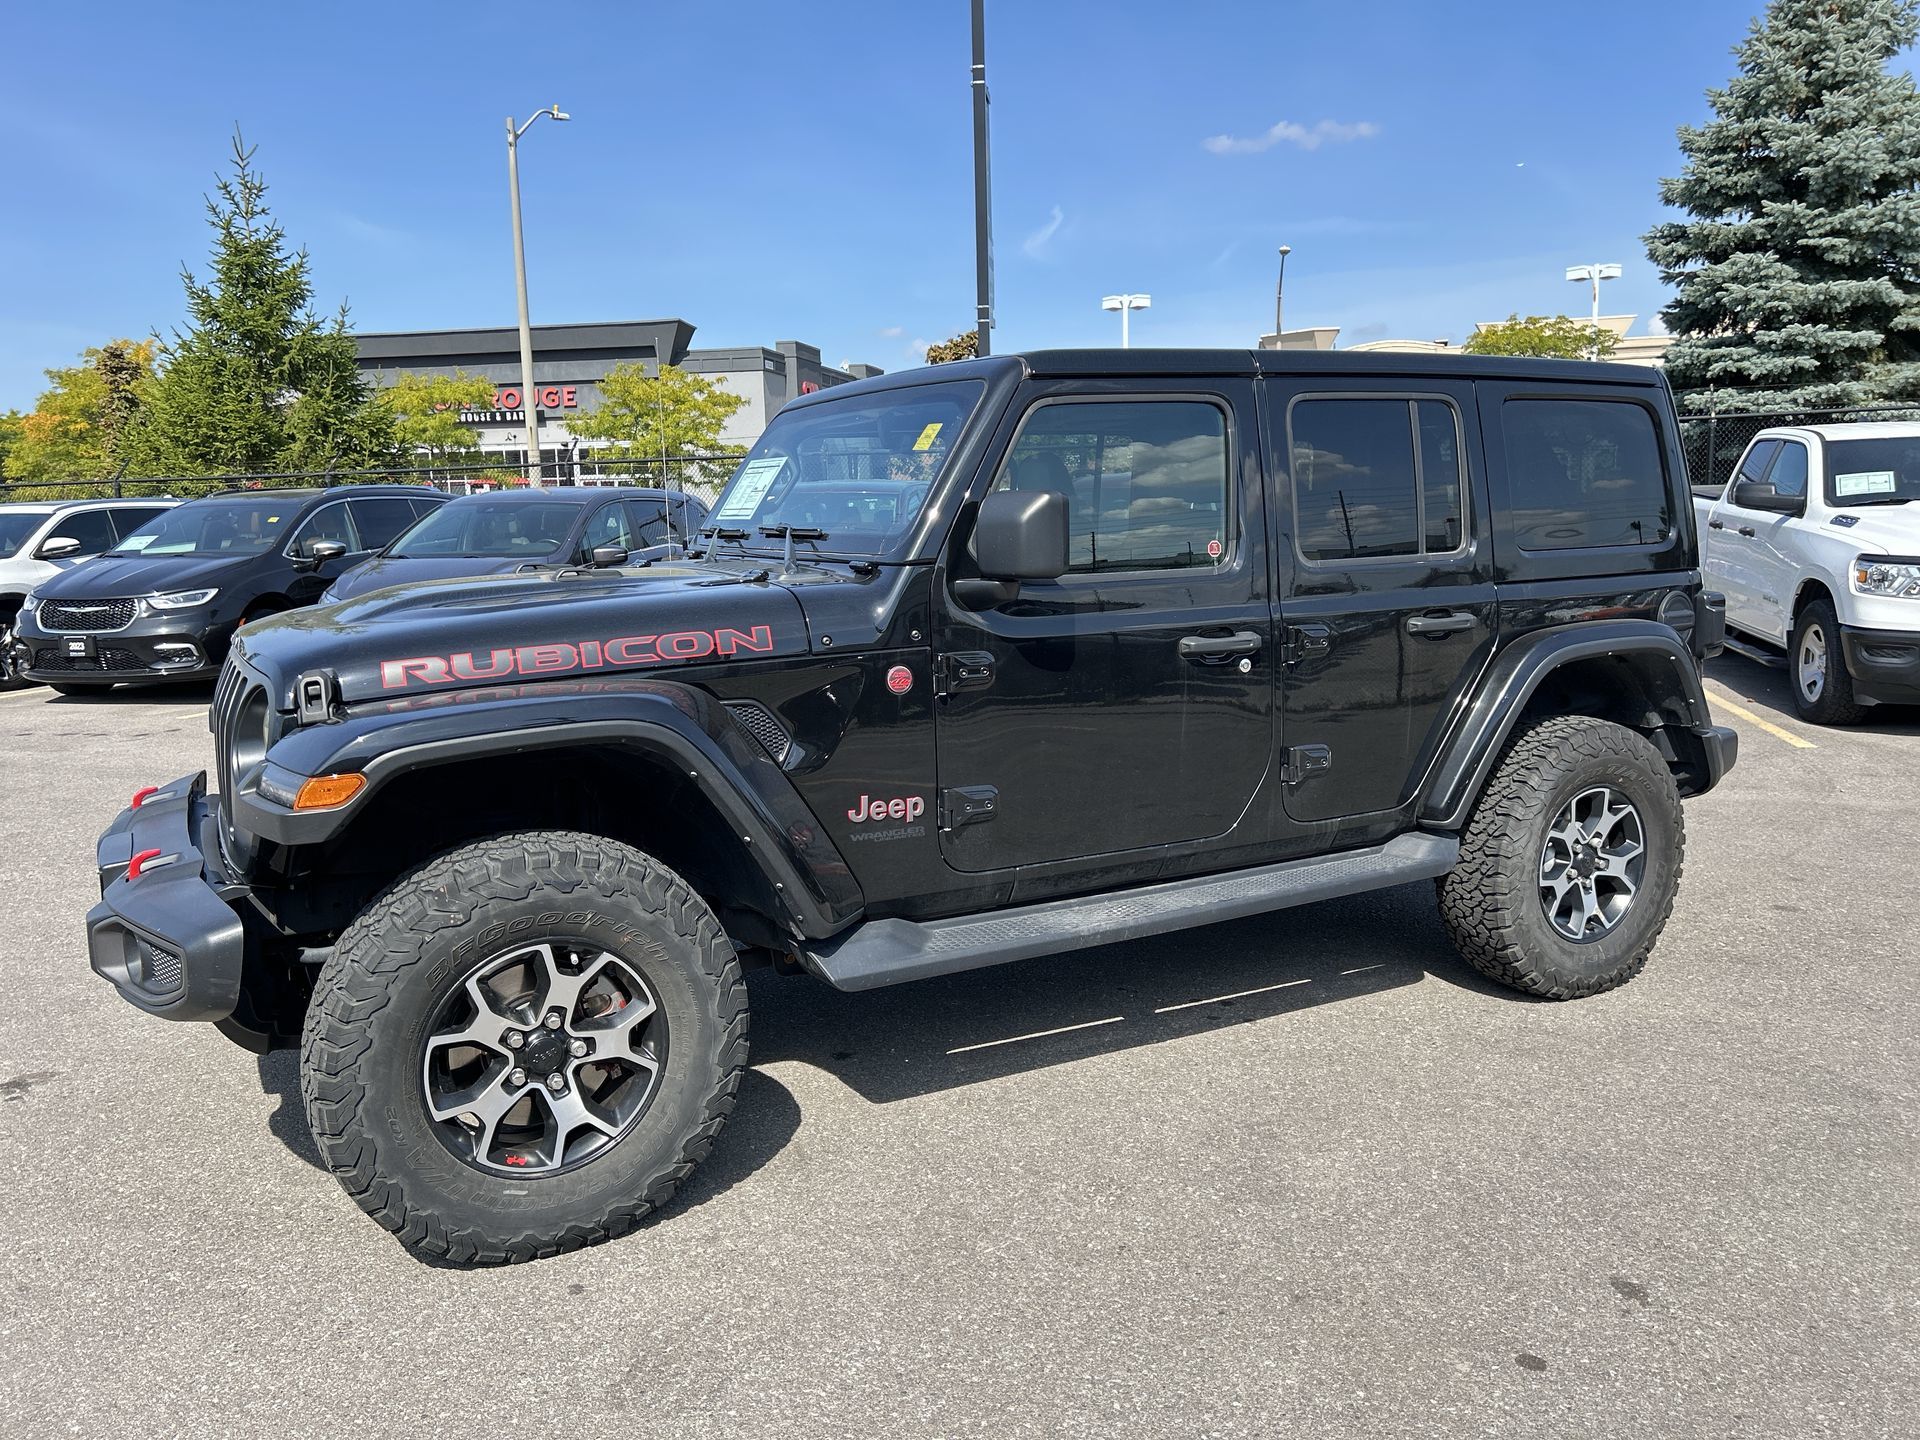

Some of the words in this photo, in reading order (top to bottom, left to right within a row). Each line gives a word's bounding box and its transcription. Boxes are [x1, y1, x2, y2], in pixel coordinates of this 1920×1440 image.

[456, 412, 491, 422] HOUSE
[496, 411, 502, 421] &
[506, 411, 525, 421] BAR
[69, 642, 85, 650] 2023
[380, 625, 773, 689] RUBICON
[847, 795, 925, 823] Jeep
[849, 826, 925, 842] WRANGLER
[425, 909, 671, 991] BFGoodrich
